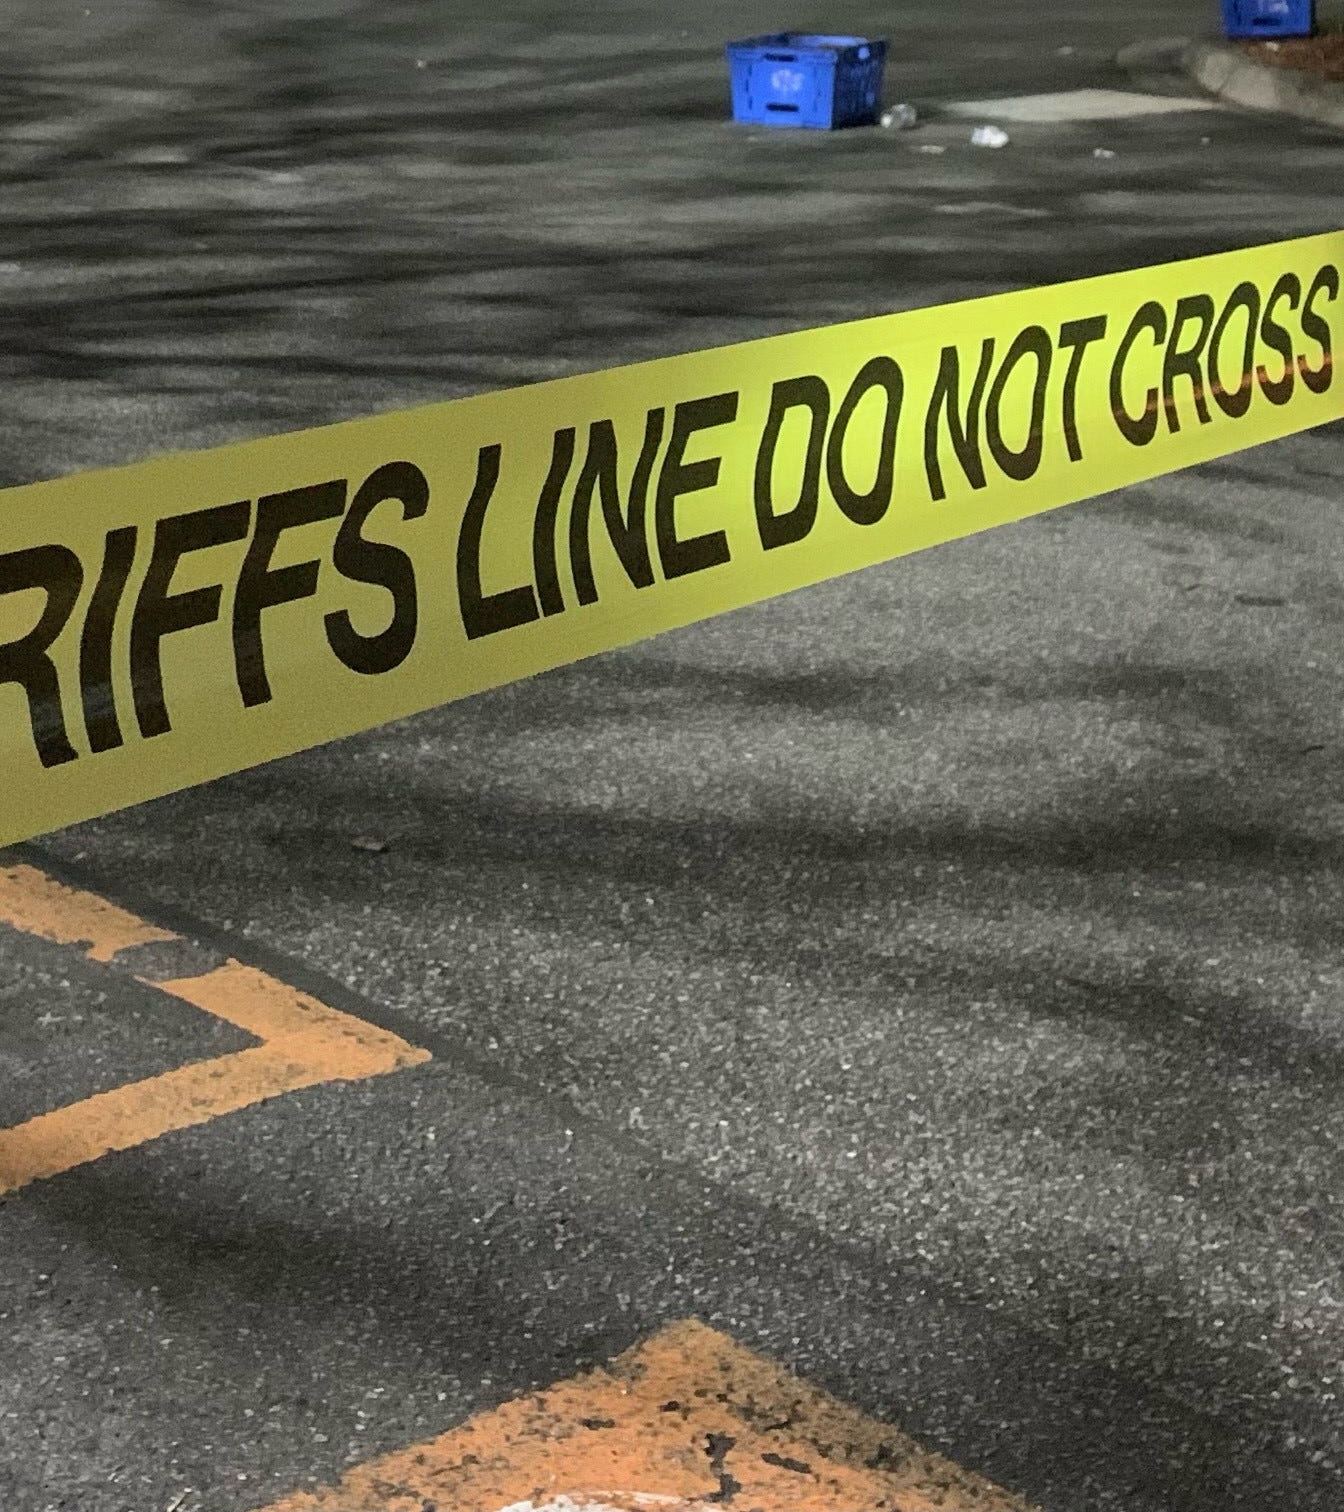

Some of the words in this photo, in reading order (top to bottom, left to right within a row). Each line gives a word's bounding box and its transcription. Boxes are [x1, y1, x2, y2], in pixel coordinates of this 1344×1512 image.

[457, 391, 739, 640] LINE
[754, 355, 904, 553] DO
[923, 315, 1107, 503] NOT
[1109, 264, 1340, 447] CROSS
